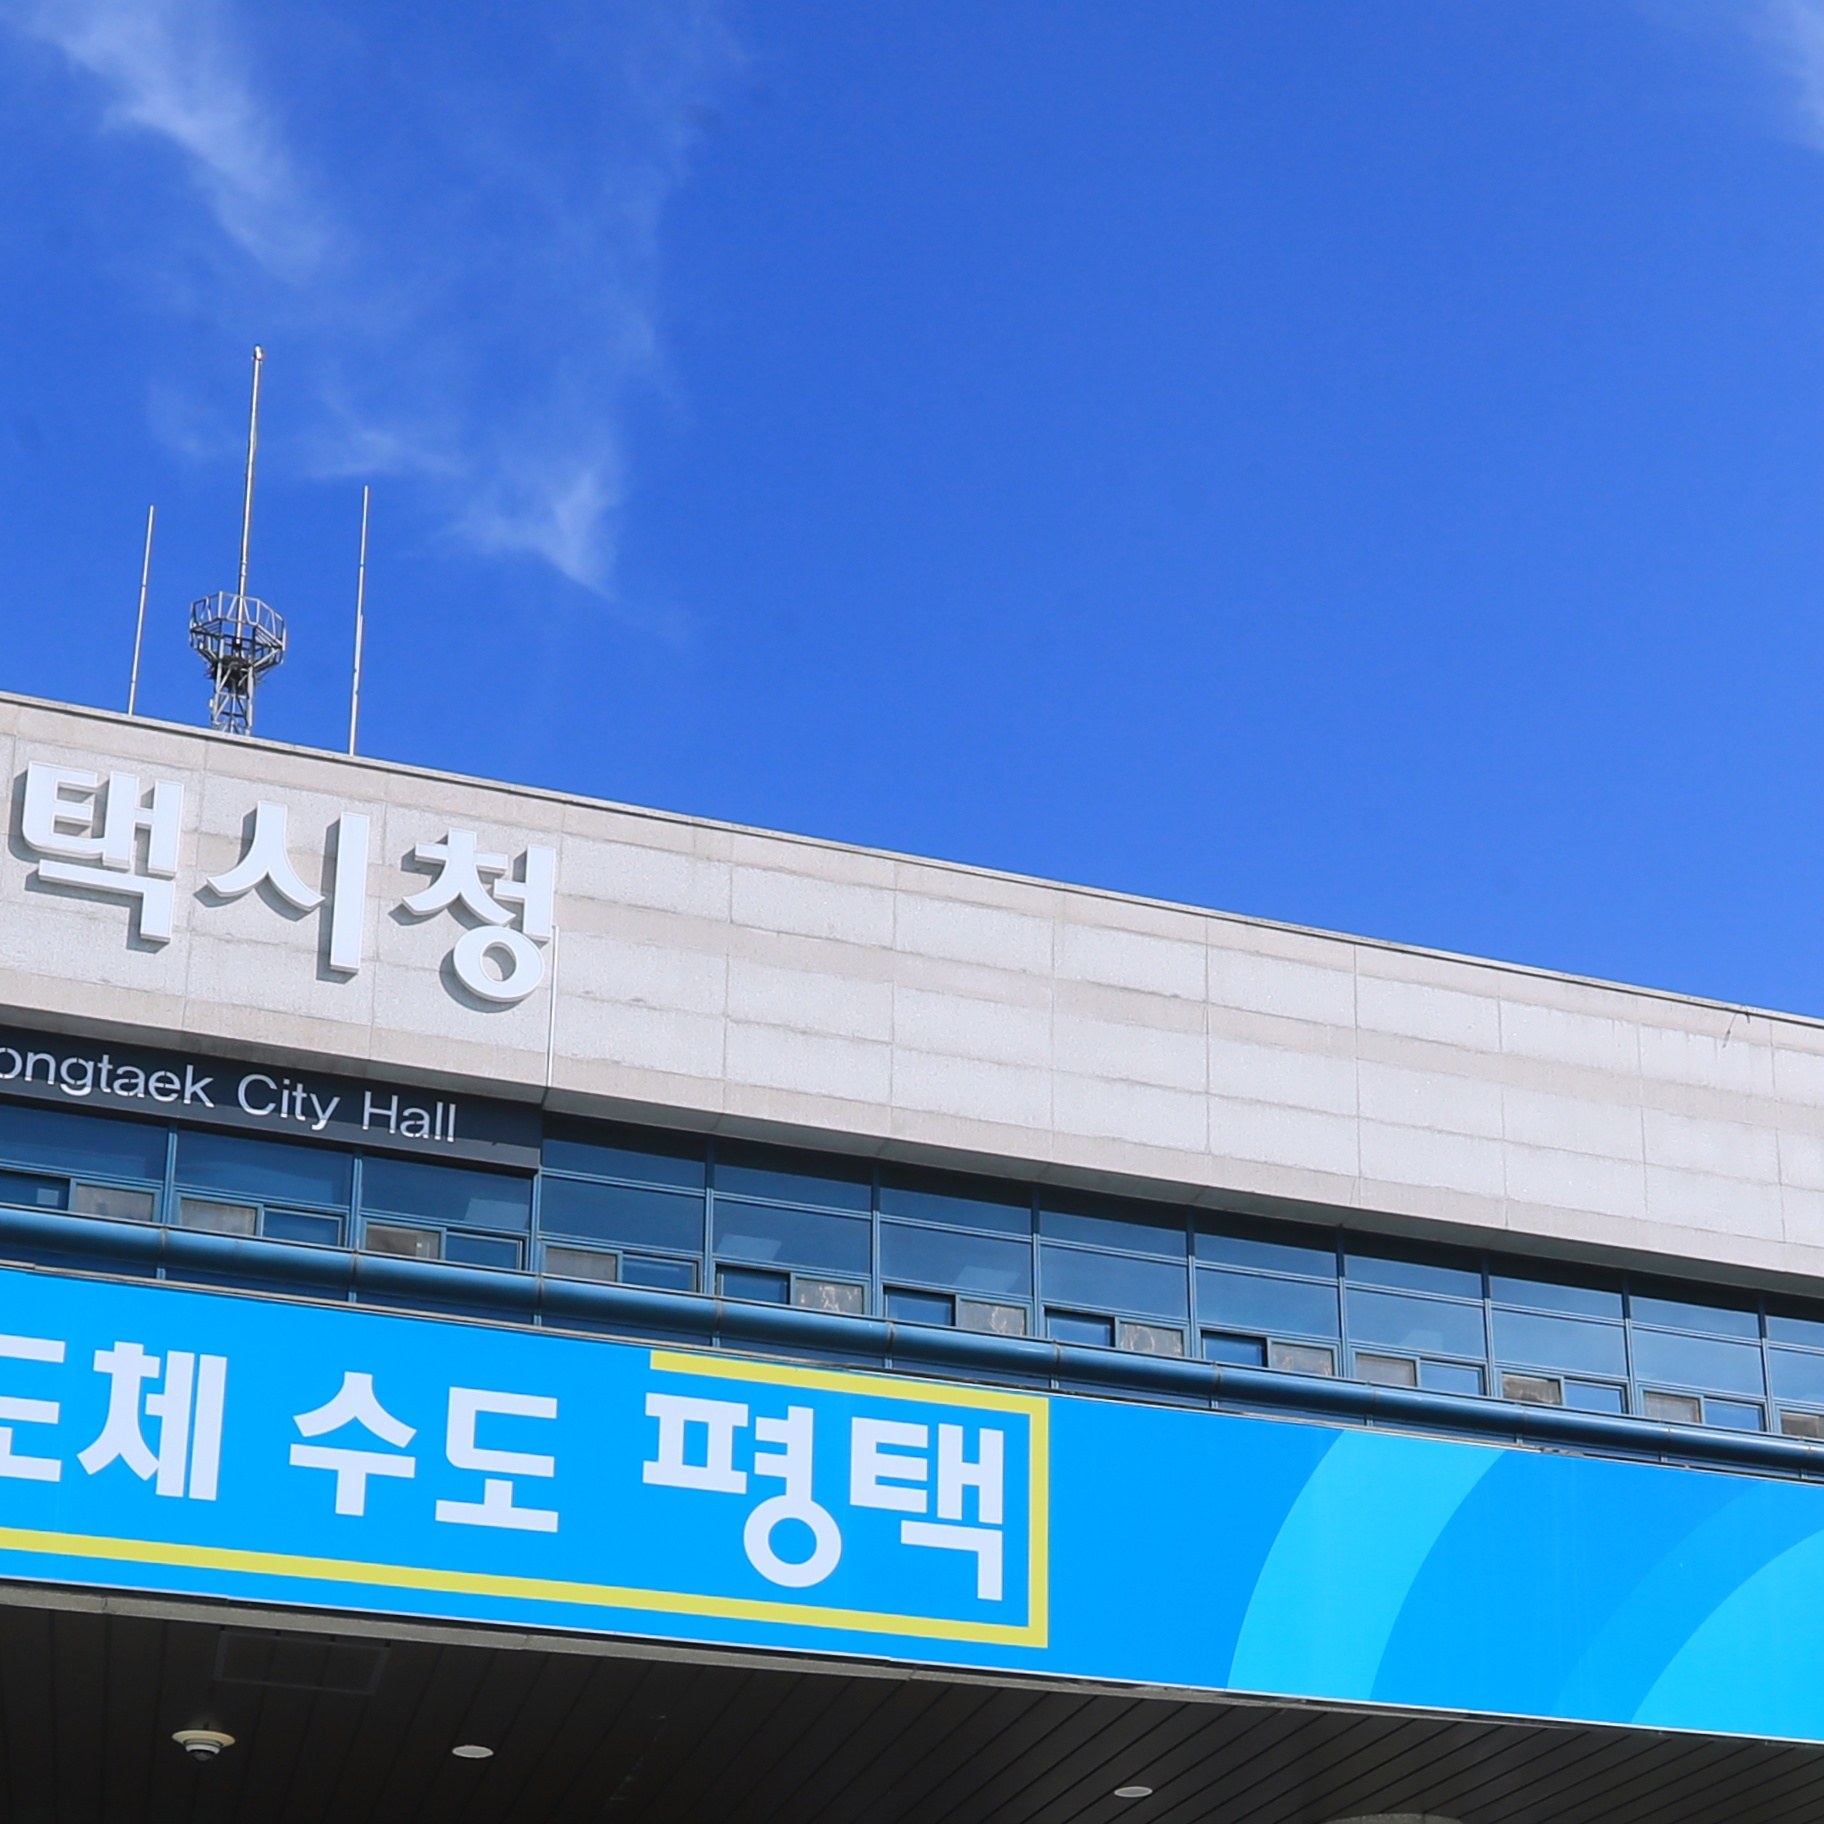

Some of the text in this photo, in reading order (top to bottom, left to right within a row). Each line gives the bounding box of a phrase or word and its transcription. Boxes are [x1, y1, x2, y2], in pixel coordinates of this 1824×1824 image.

[237, 1074, 340, 1131] City
[362, 1091, 457, 1143] Hall
[288, 1372, 559, 1533] 수도
[642, 1392, 1004, 1602] 평택
